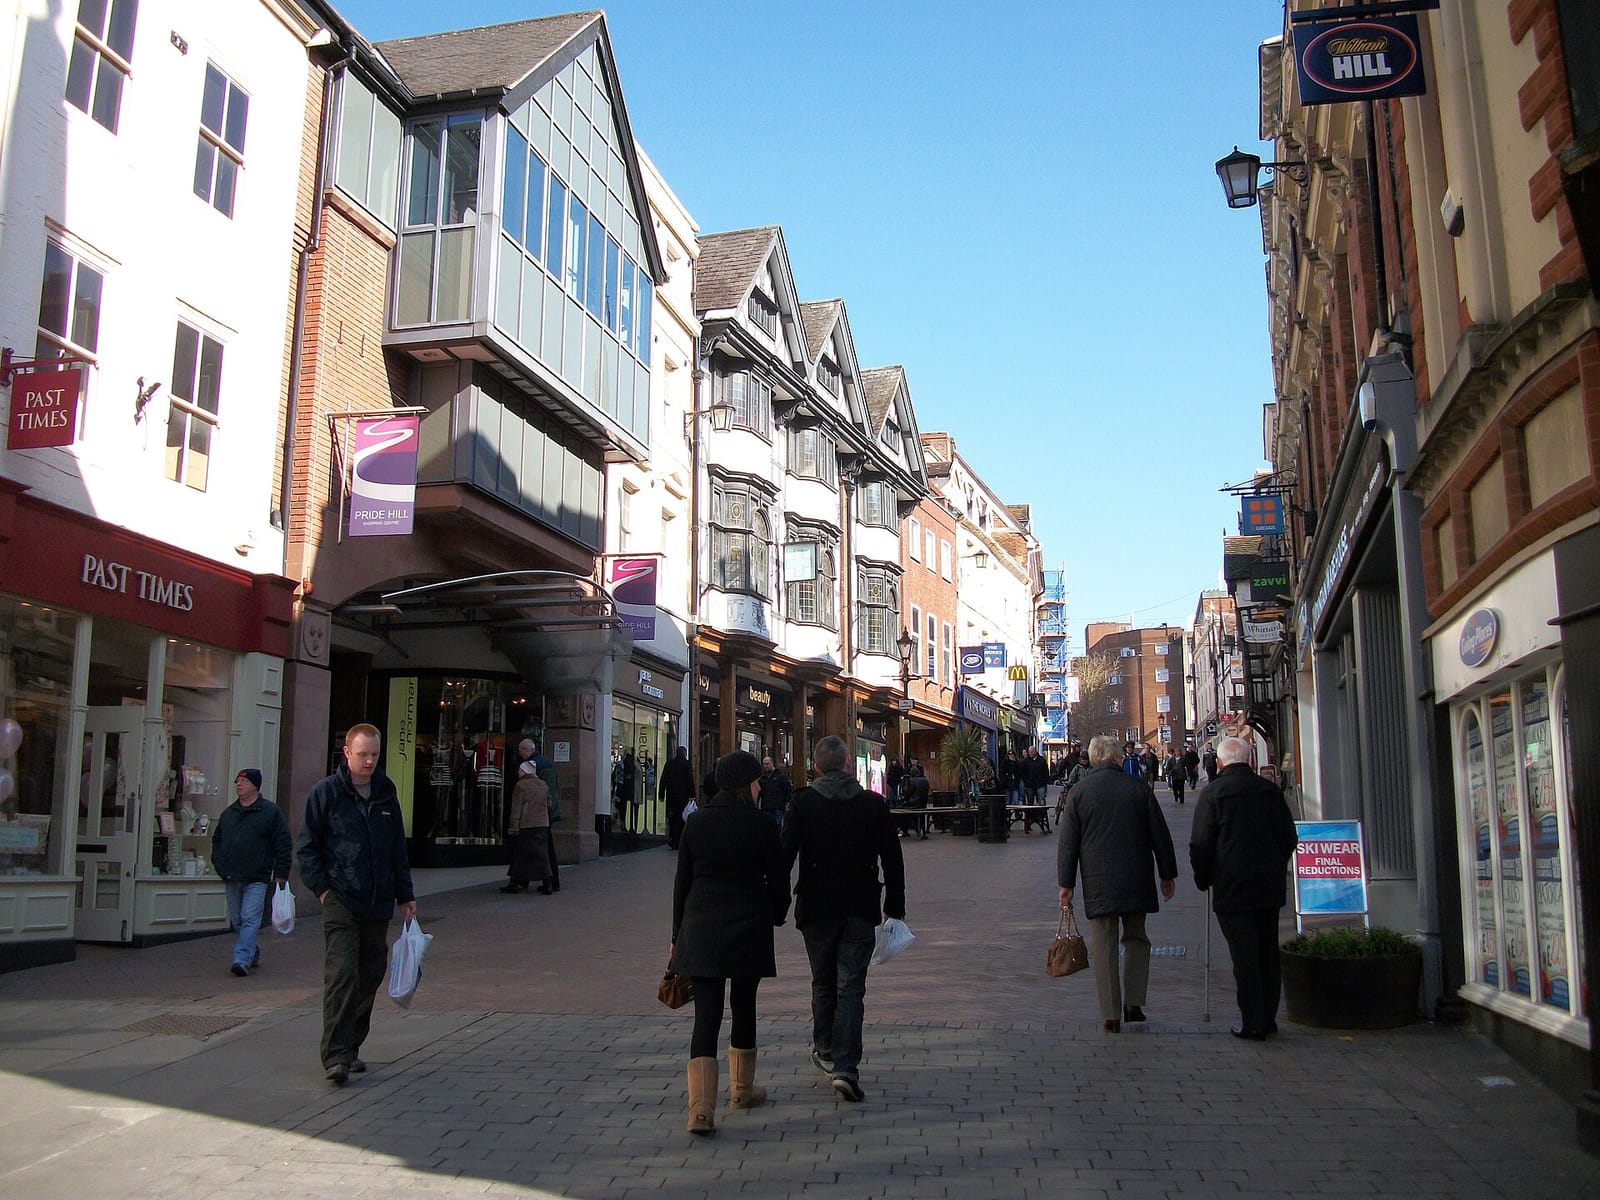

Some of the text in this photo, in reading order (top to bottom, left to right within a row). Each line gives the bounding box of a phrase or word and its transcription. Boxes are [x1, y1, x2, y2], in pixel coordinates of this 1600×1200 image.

[1328, 36, 1388, 55] William
[1333, 53, 1392, 80] HILL
[25, 388, 65, 409] PAST
[17, 409, 68, 430] TIMES
[354, 509, 409, 520] PRIDE HILL
[81, 554, 194, 612] PAST TIMES
[1253, 574, 1287, 588] zavvi
[1247, 622, 1281, 634] Whittard
[749, 685, 771, 707] beauty
[399, 720, 408, 762] jane
[1297, 842, 1360, 854] SKI WEAR
[1298, 866, 1360, 875] REDUCTIONS
[1315, 857, 1342, 866] FINAL
